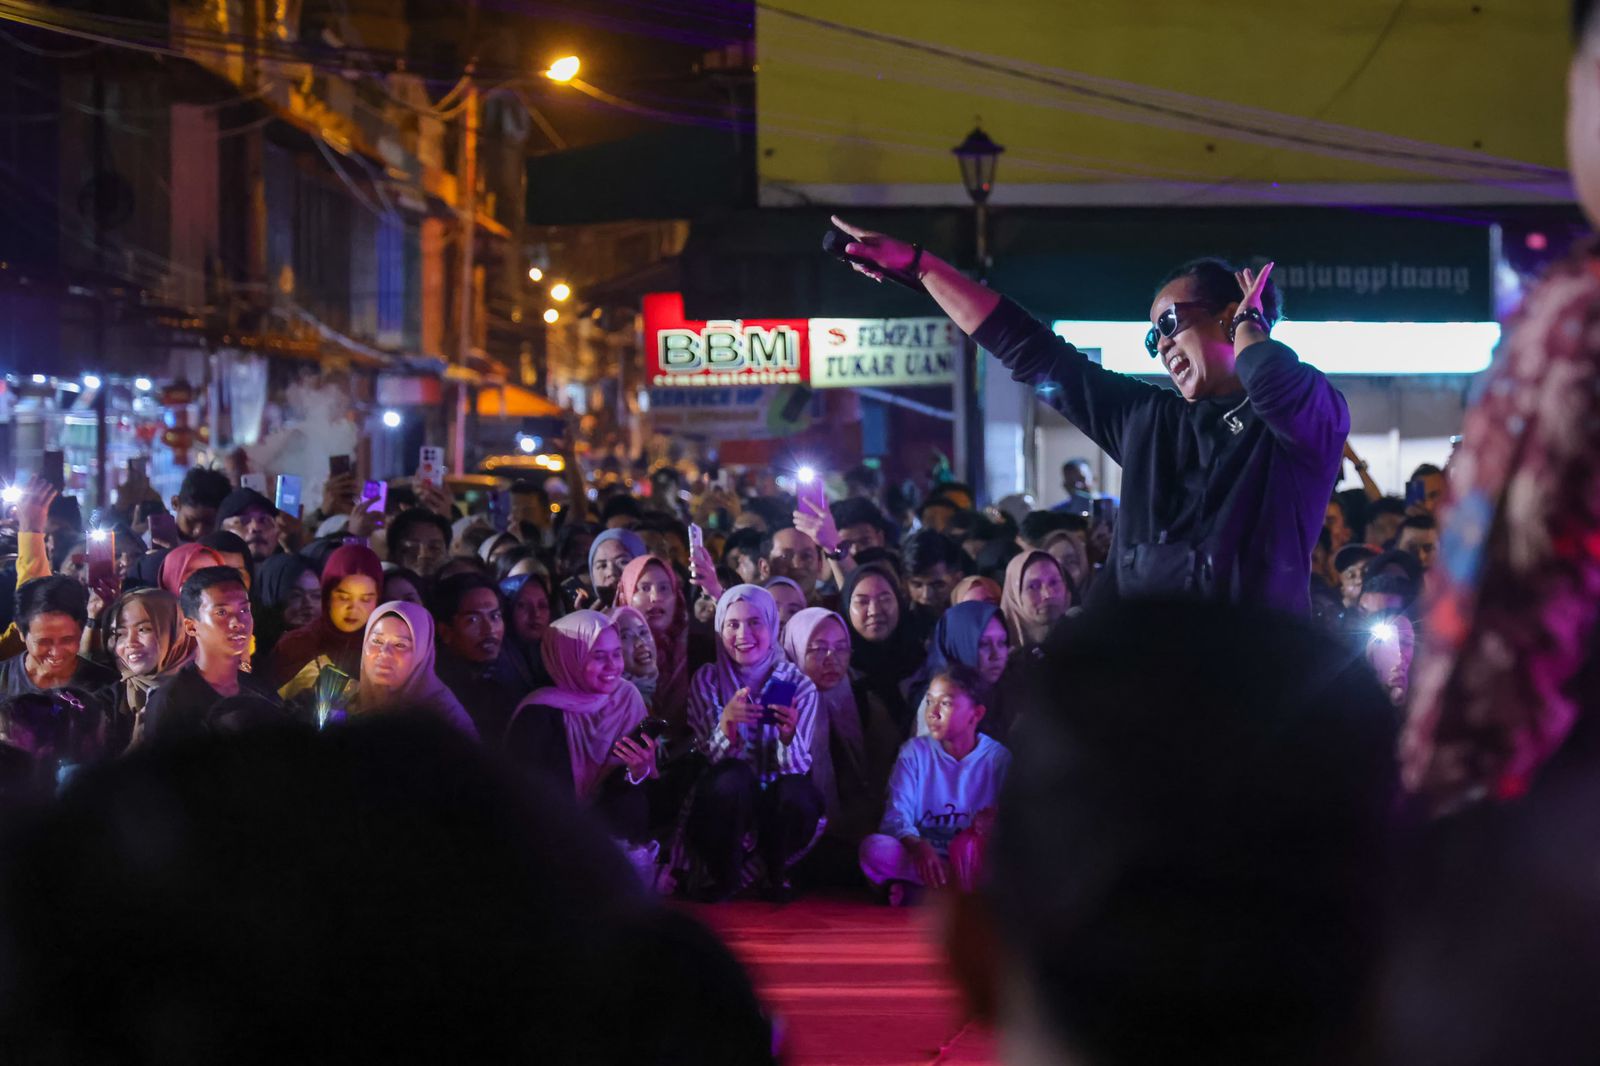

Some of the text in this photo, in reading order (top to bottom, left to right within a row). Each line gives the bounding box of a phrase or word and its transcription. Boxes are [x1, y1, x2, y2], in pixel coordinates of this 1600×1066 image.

[1252, 257, 1470, 294] anjungpinang
[657, 320, 800, 373] BBM
[826, 353, 953, 378] TUKAR UAN
